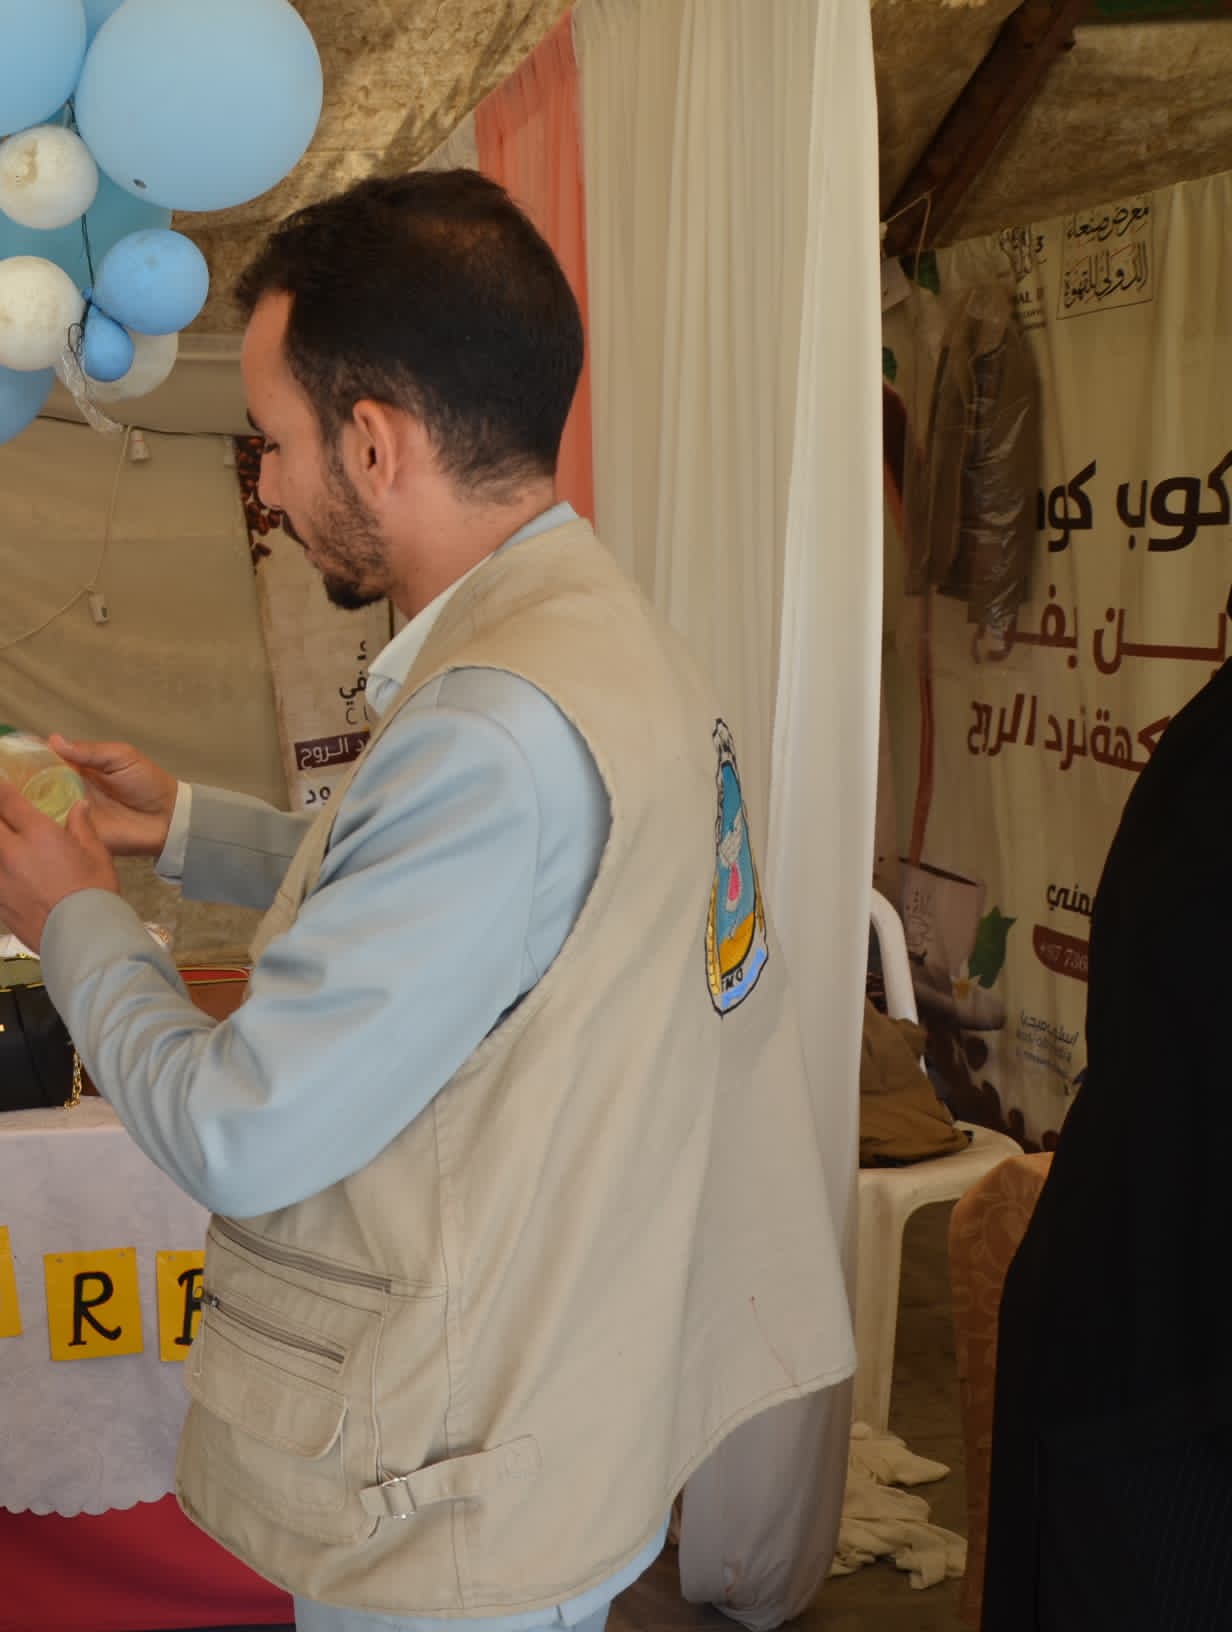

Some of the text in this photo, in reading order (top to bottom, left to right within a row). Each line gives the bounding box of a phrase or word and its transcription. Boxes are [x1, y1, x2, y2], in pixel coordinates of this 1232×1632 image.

[1036, 459, 1097, 553] كو
[300, 735, 350, 769] الروح
[1089, 706, 1171, 773] كهة
